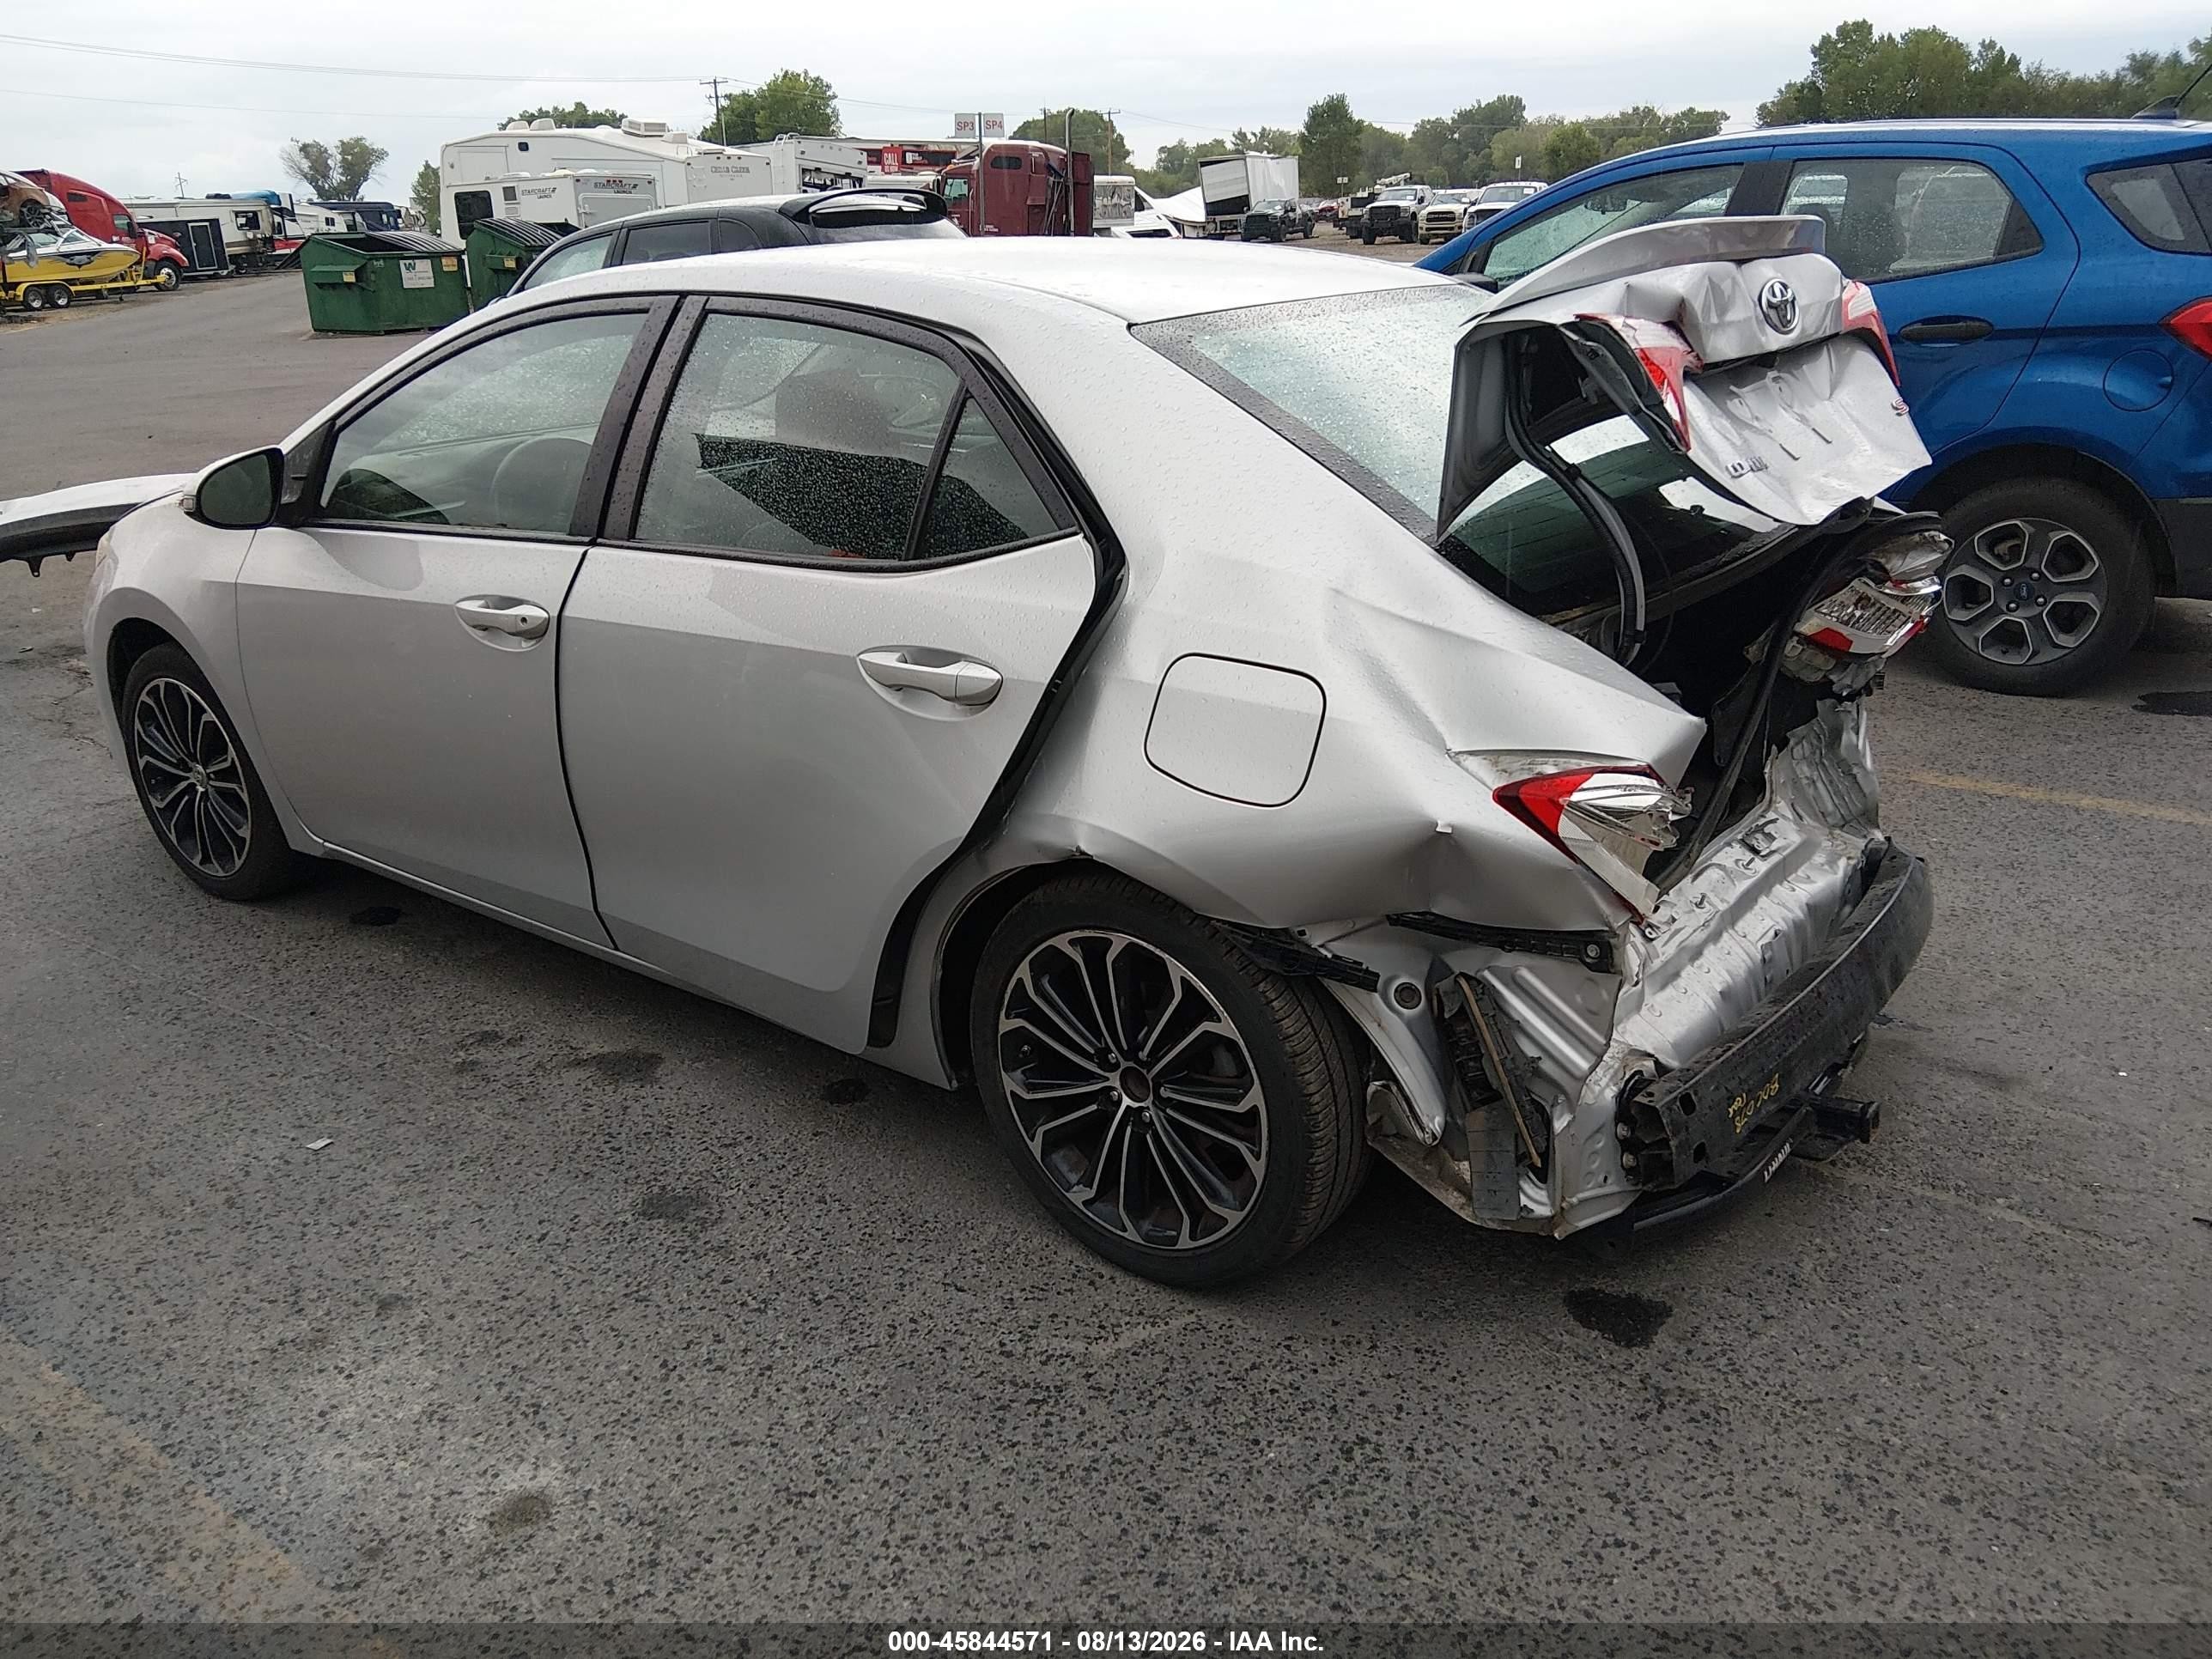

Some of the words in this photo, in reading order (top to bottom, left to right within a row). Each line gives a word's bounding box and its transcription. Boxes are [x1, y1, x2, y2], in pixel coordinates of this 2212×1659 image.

[957, 120, 975, 131] SP3
[986, 119, 1003, 130] SP4
[884, 152, 898, 166] CALL
[521, 186, 552, 196] STARCRAFT
[593, 181, 632, 190] STARCRAFT
[1763, 1141, 1792, 1183] U-HAUL
